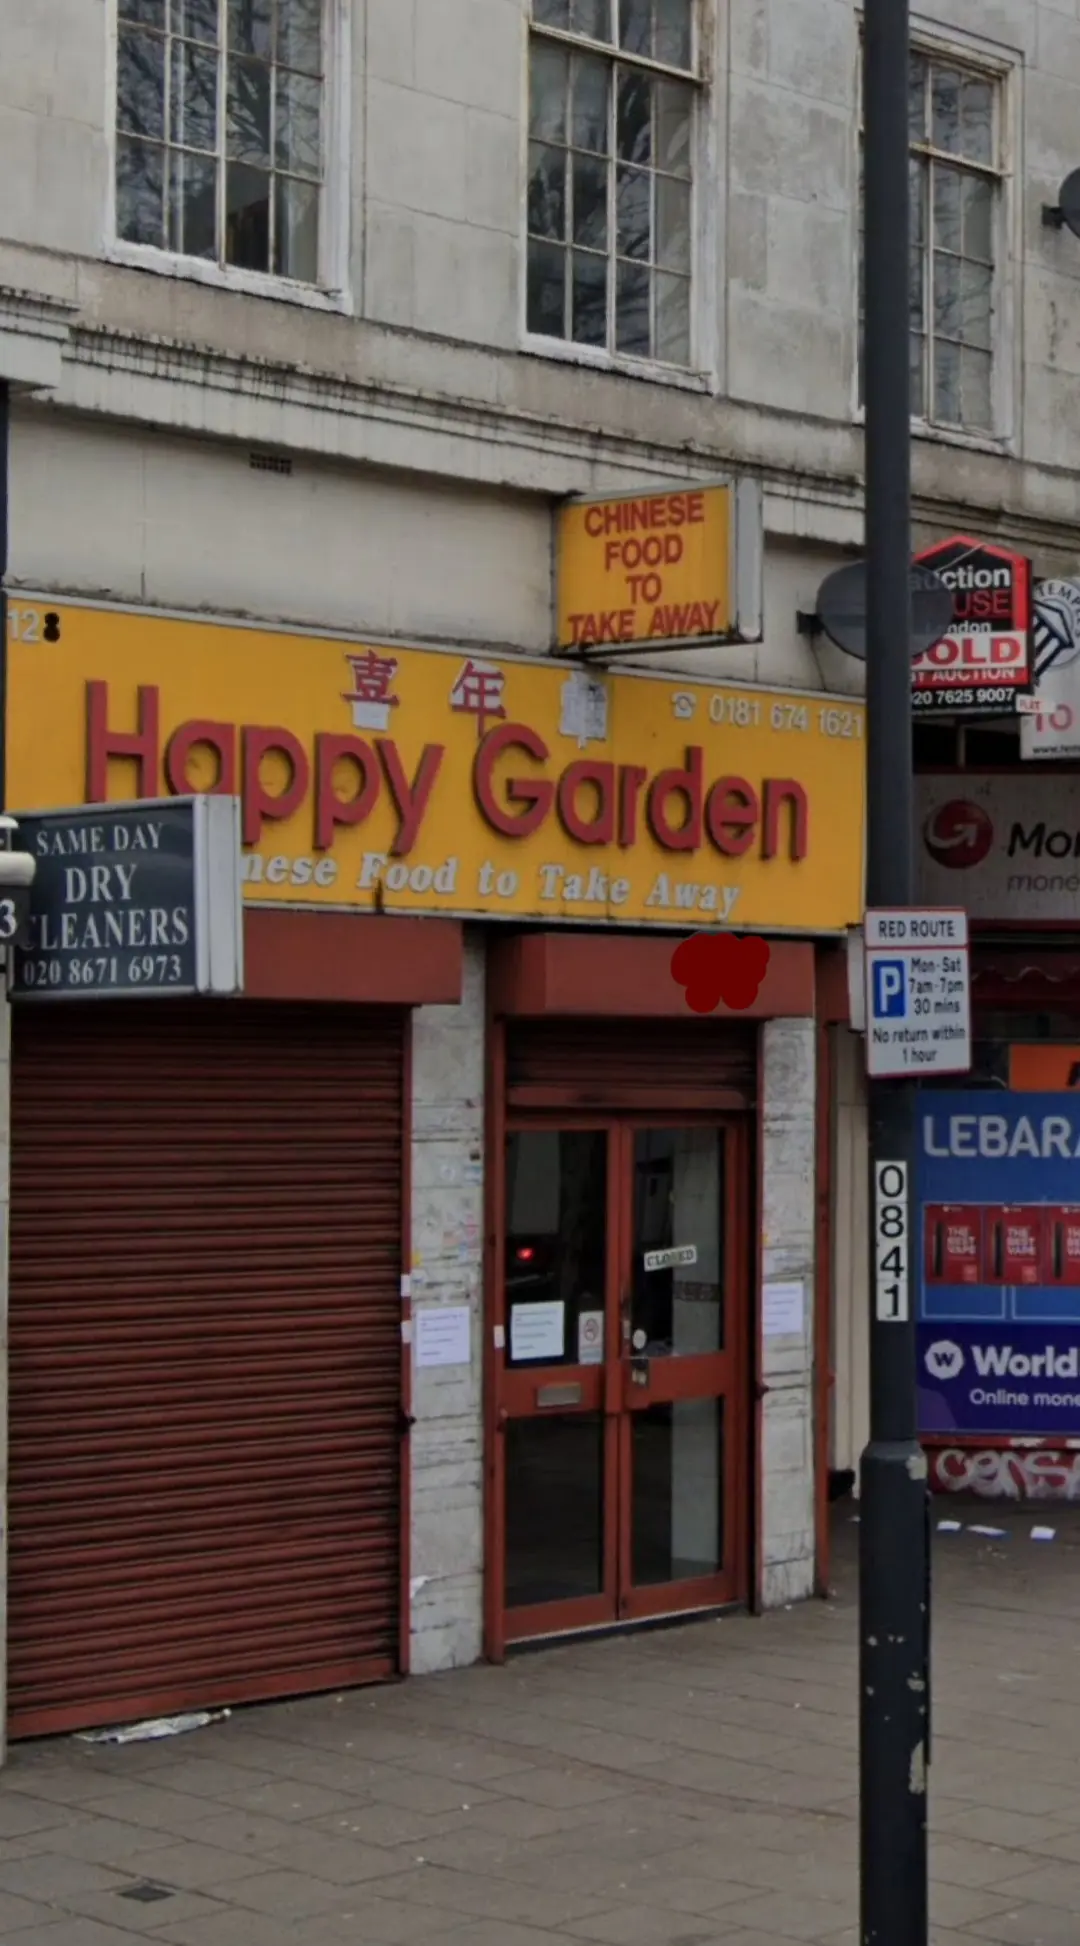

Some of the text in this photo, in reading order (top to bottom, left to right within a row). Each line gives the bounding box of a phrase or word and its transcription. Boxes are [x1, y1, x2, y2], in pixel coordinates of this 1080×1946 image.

[584, 493, 705, 538] CHINESE
[604, 533, 683, 572] FOOD
[624, 571, 662, 604] TO
[568, 600, 720, 645] TAKE AWAY
[911, 637, 1021, 666] OLD
[935, 689, 974, 705] 7625
[976, 687, 1015, 703] 9007
[709, 693, 864, 738] 0181 674 1621
[85, 679, 809, 862] Happy Garden
[36, 822, 163, 857] SAME DAY
[1007, 822, 1080, 859] Mo
[64, 863, 138, 904] DRY
[356, 851, 458, 893] Food
[477, 859, 519, 897] to
[539, 863, 632, 905] Take
[646, 872, 741, 922] Away
[24, 906, 190, 951] LEANERS
[879, 919, 955, 938] RED ROUTE
[23, 954, 182, 986] 020 8671 6973
[914, 997, 961, 1016] 30 mins
[873, 1023, 965, 1043] No return within
[902, 1047, 938, 1063] 1 hour
[923, 1115, 1080, 1158] LEBAR
[647, 1249, 695, 1267] CLOED
[970, 1344, 1079, 1378] World
[969, 1388, 1030, 1406] Online
